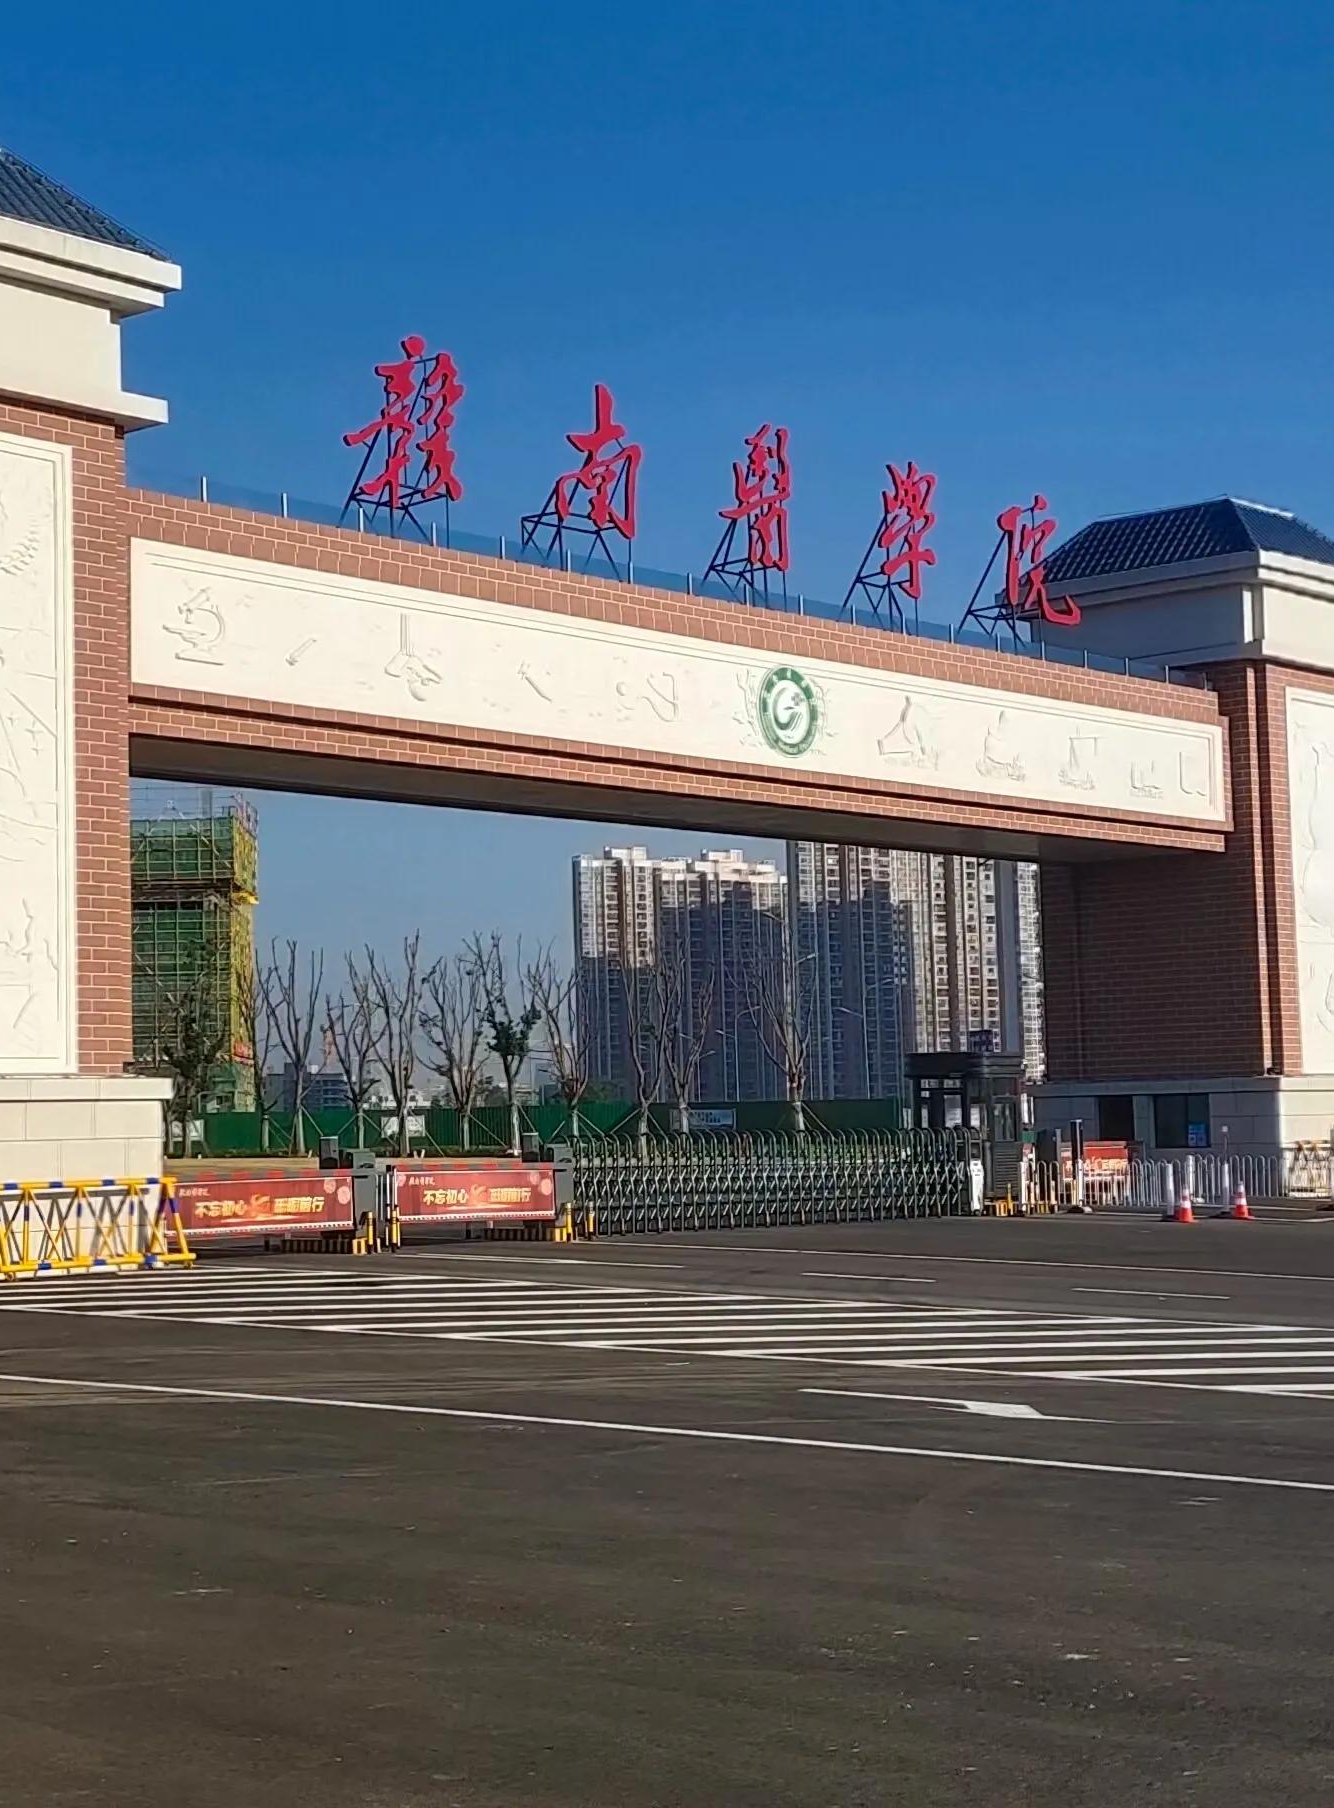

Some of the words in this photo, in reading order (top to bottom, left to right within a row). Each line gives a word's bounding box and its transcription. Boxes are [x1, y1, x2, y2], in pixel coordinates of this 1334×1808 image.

[423, 1188, 468, 1205] 不忘初心
[195, 1199, 247, 1218] 不忘初心
